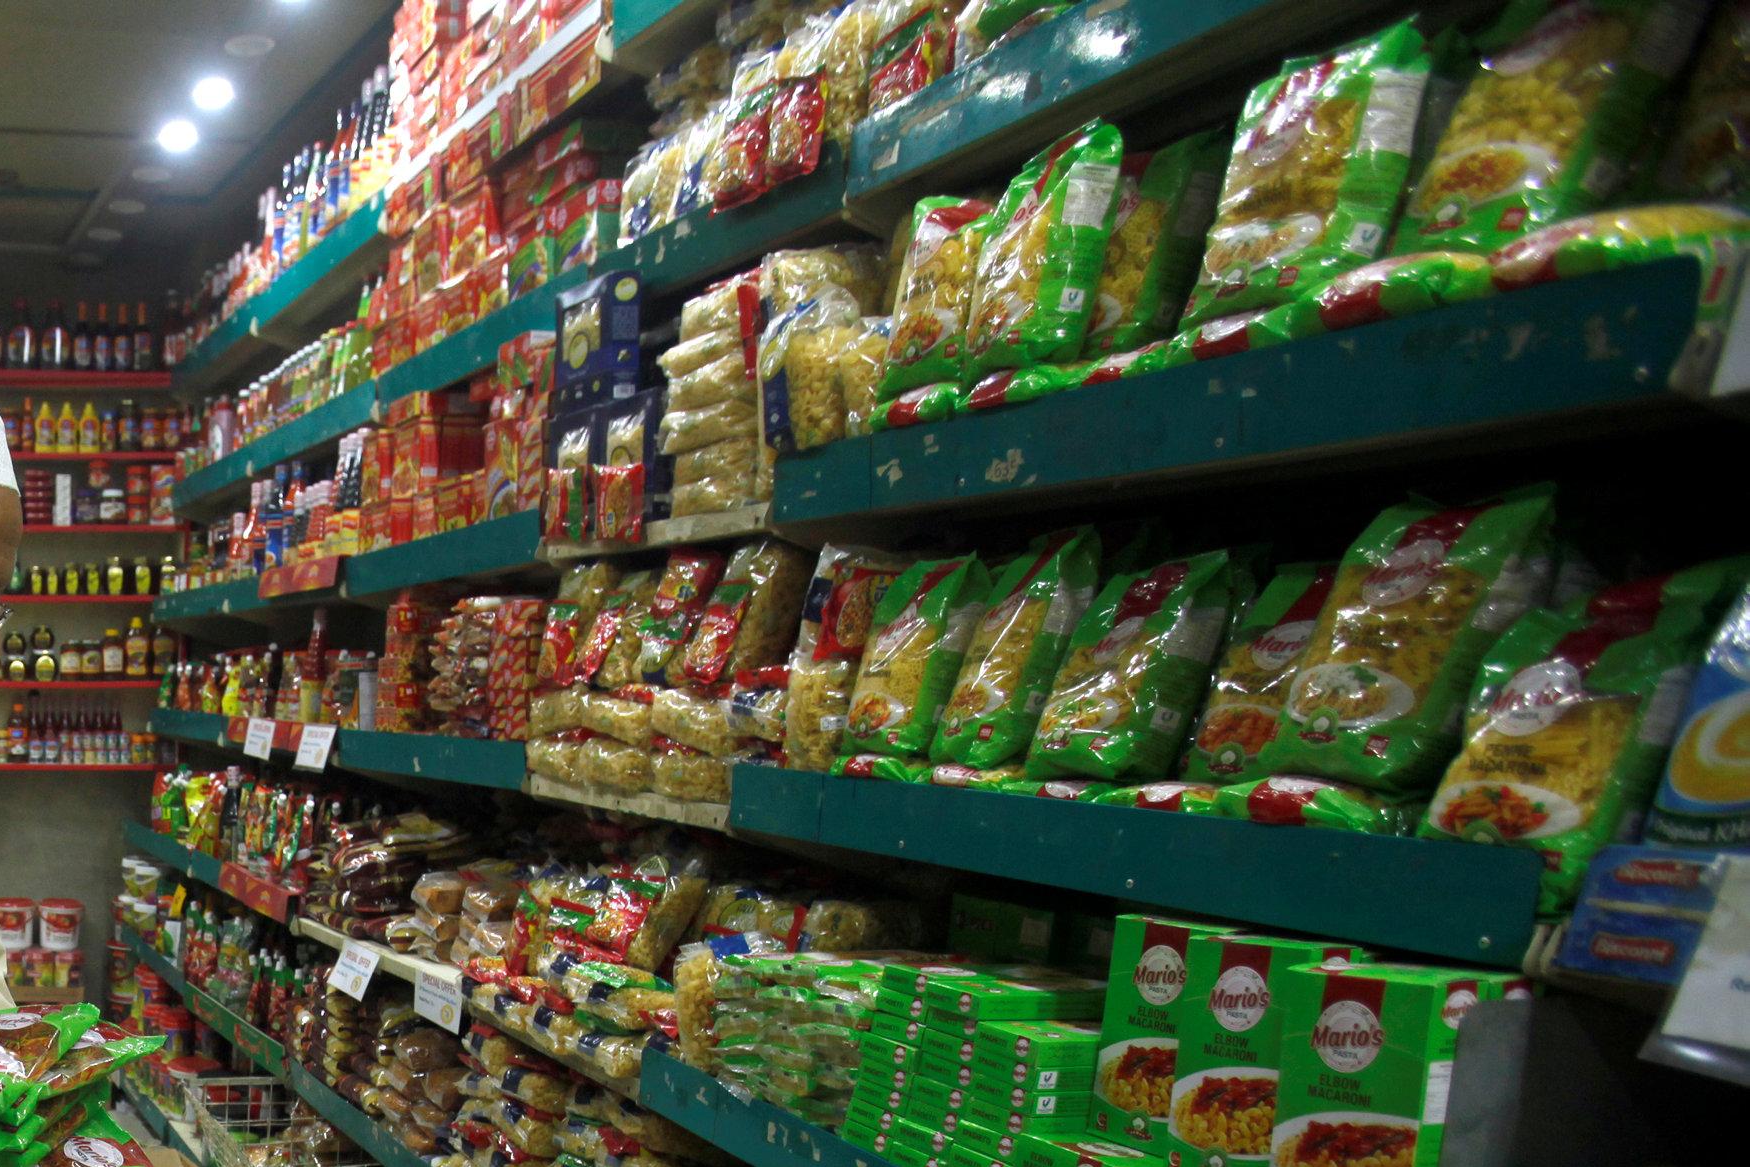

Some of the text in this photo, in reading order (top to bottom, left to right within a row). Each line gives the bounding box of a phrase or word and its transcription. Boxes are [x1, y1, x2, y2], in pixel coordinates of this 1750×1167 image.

[1132, 965, 1187, 986] Mario's
[1209, 987, 1270, 1010] Mario's
[1213, 1032, 1249, 1049] ELBOW
[1310, 1025, 1383, 1049] Mario's
[1203, 1043, 1257, 1063] MACARONI
[1318, 1073, 1361, 1092] ELBOW
[1306, 1085, 1372, 1108] MACARONI
